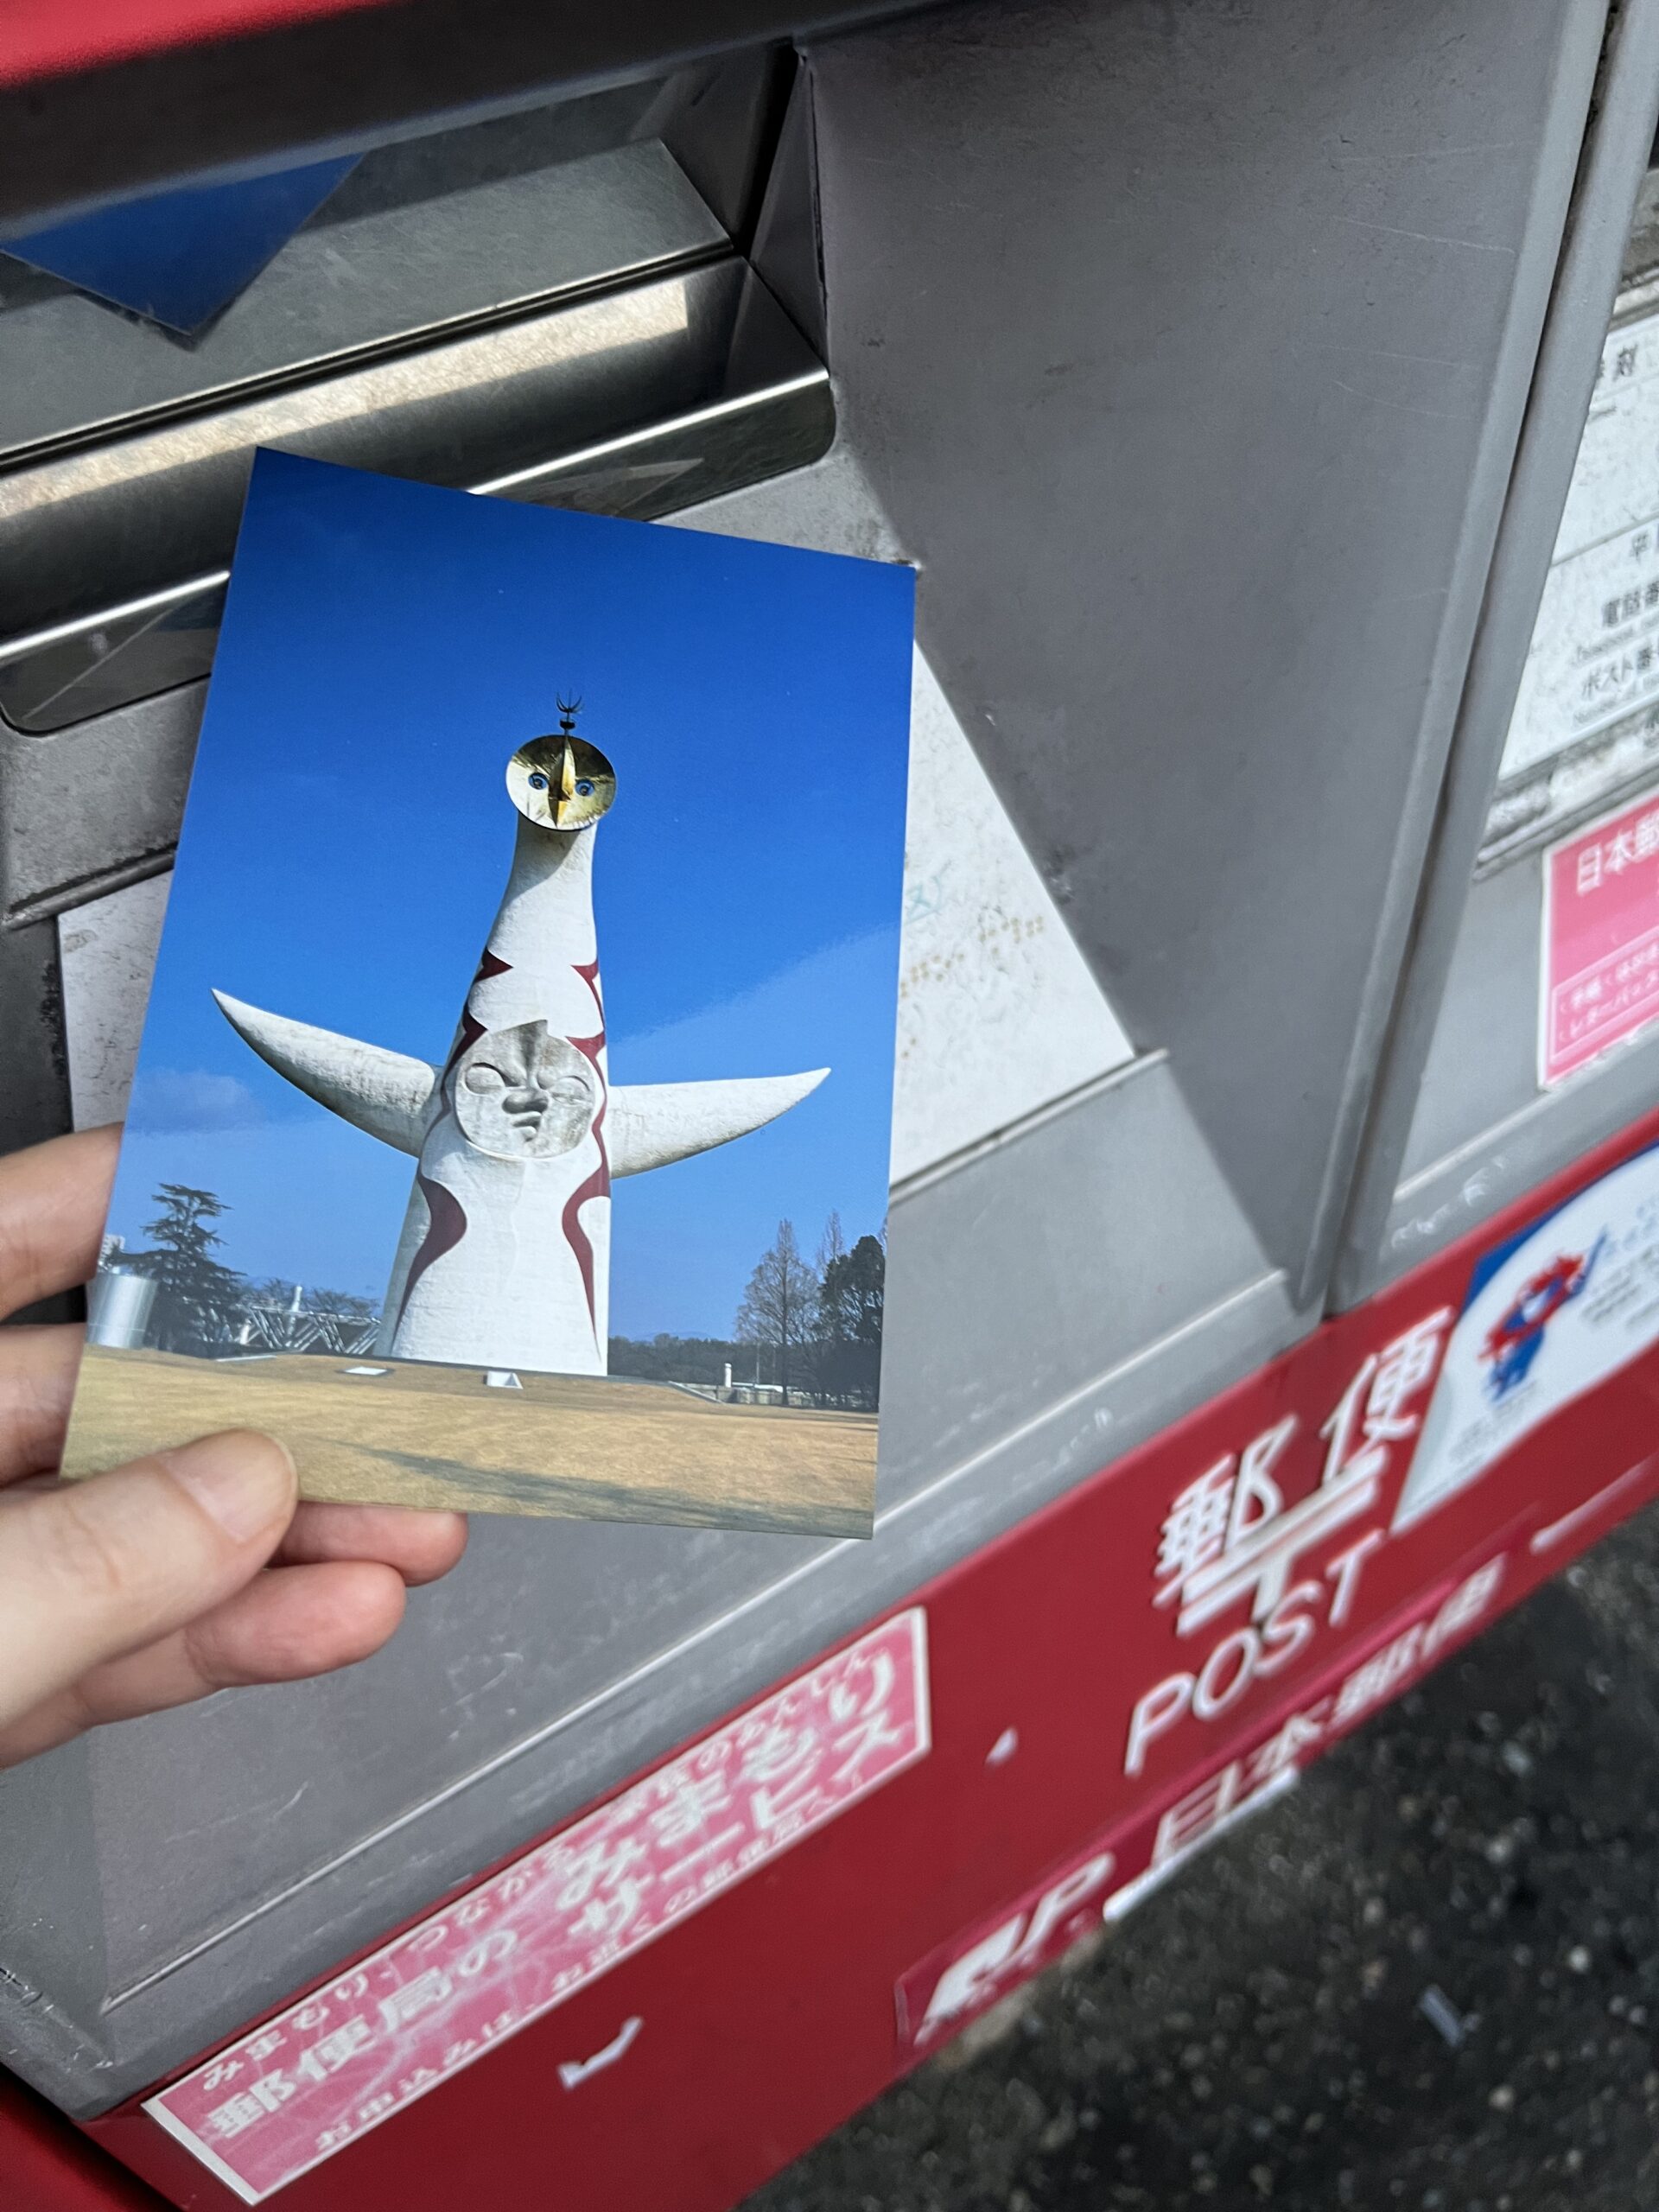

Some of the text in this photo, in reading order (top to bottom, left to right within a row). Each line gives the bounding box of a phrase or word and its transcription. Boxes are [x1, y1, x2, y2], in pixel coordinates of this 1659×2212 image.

[1153, 1305, 1455, 1607] 郵便
[1125, 1528, 1384, 1775] POST
[1151, 1555, 1505, 1865] 日本郵便
[553, 1652, 895, 1911] みまもり
[568, 1711, 902, 1936] サービス
[206, 1929, 518, 2141] 郵便局の
